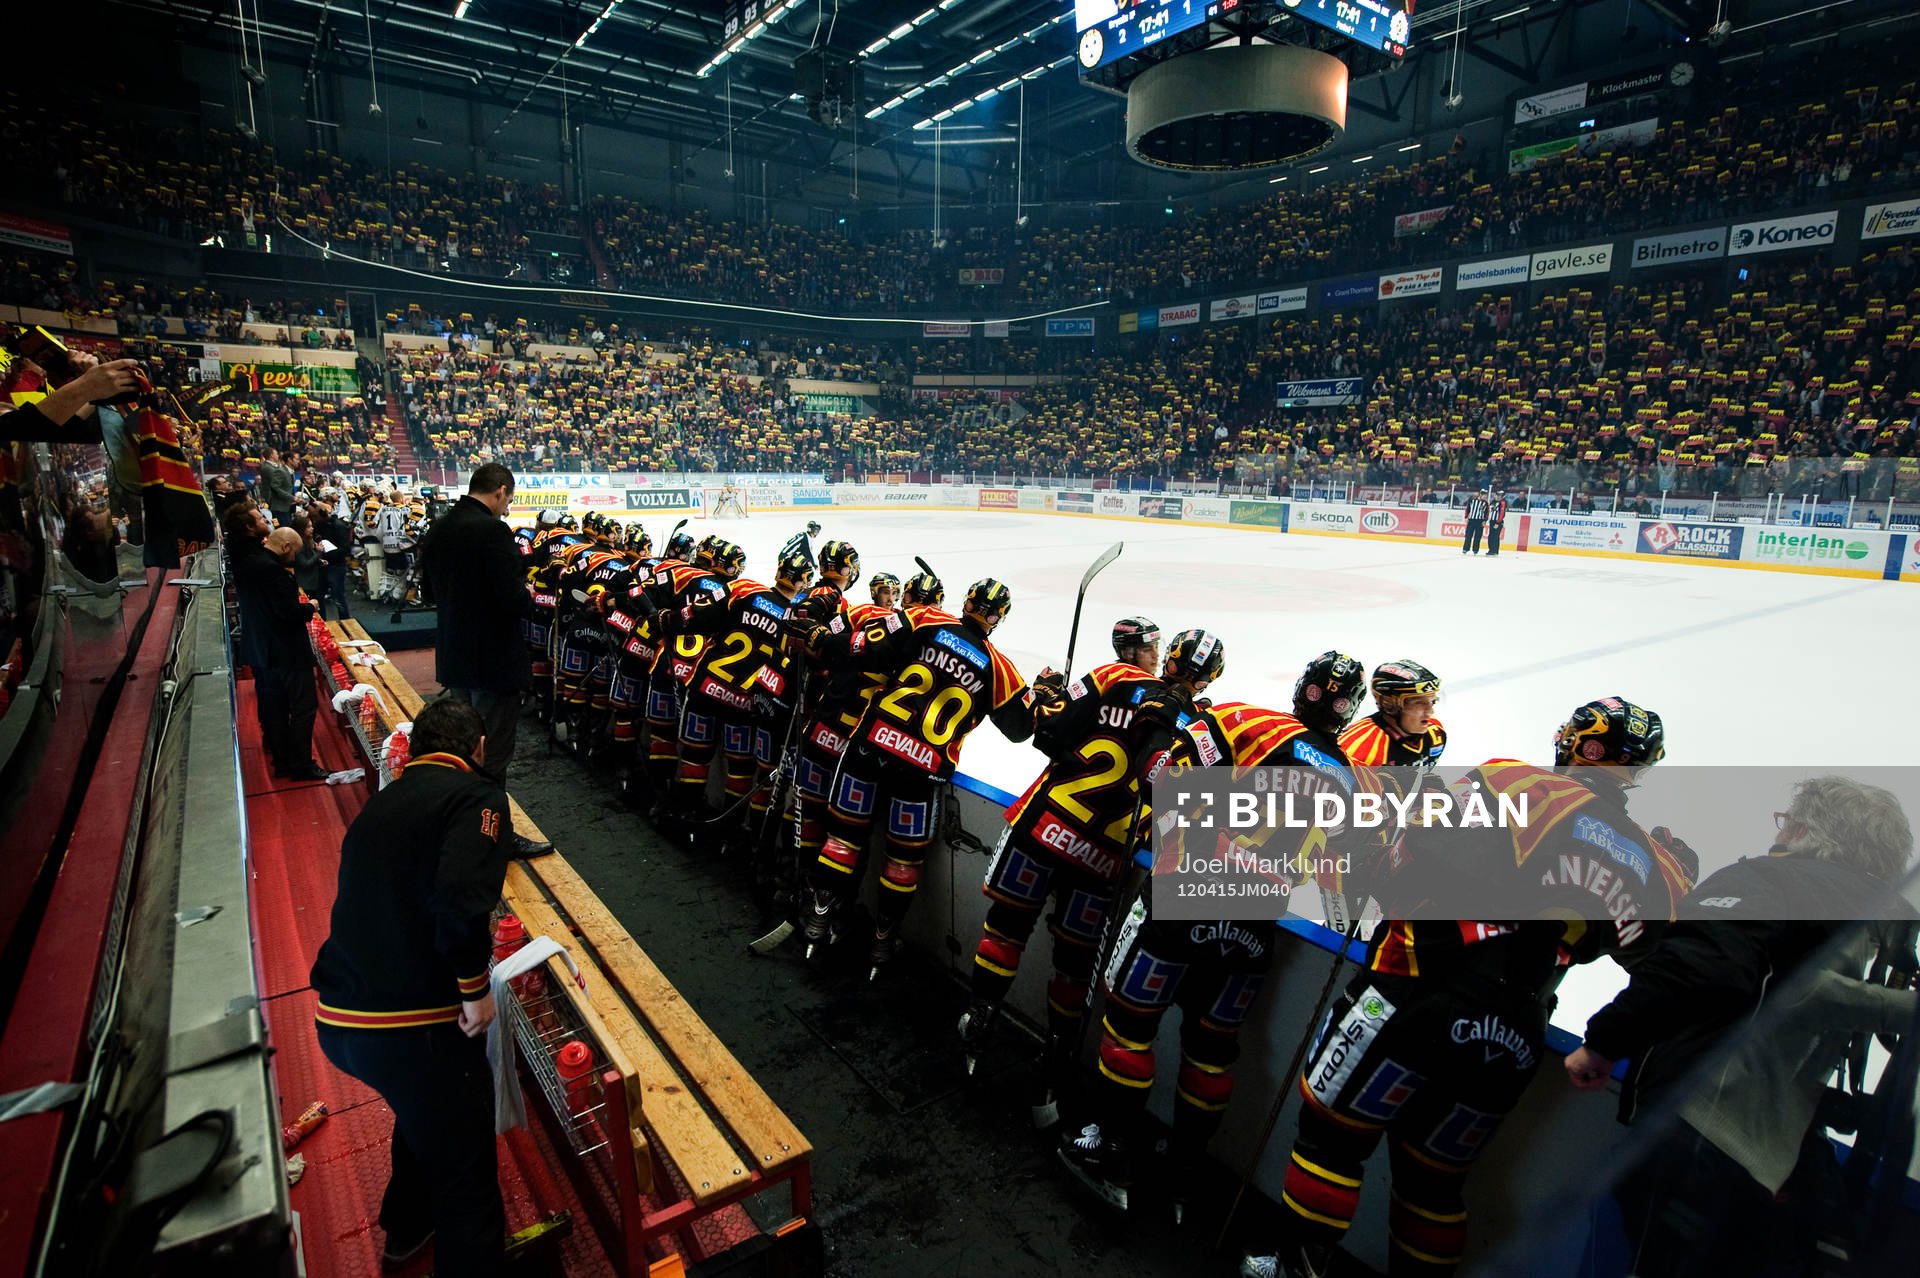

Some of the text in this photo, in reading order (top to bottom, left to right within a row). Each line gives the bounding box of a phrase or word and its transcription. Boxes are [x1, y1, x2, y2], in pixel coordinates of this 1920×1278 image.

[1138, 9, 1168, 34] 17:41
[1370, 17, 1377, 32] 1
[1118, 29, 1126, 44] 2
[1602, 73, 1664, 95] Klockmaster
[1757, 223, 1833, 246] Koneo
[1886, 219, 1917, 230] Cater
[1636, 236, 1720, 261] Bilmetro
[1458, 265, 1527, 282] Handelsbanken
[1535, 251, 1607, 276] gavle.se
[1160, 308, 1198, 322] STRABAG
[229, 363, 310, 388] Ceers
[630, 493, 686, 507] VOLVIA
[793, 489, 831, 498] SANDVIK
[1103, 496, 1124, 508] Coffee
[1311, 512, 1354, 524] ŠKODA
[1370, 512, 1390, 527] mlt
[1541, 518, 1628, 529] THUNBERGS BIL
[1891, 524, 1918, 532] VOLVIA
[1653, 526, 1668, 544] R
[1677, 526, 1732, 545] ROCK
[1758, 530, 1844, 550] interlan
[1674, 541, 1729, 555] KLASSIKER
[741, 611, 779, 641] ROHD
[919, 645, 984, 694] JONSSON
[1327, 679, 1339, 693] 15
[879, 663, 974, 747] 20
[815, 728, 848, 755] GEVA
[874, 727, 936, 770] GEVALIA
[1200, 736, 1217, 764] valbo
[1040, 823, 1115, 879] GEVALIA
[1190, 920, 1265, 959] Callaway
[1450, 1013, 1536, 1071] Callaway
[1313, 1020, 1364, 1095] ŠKODA
